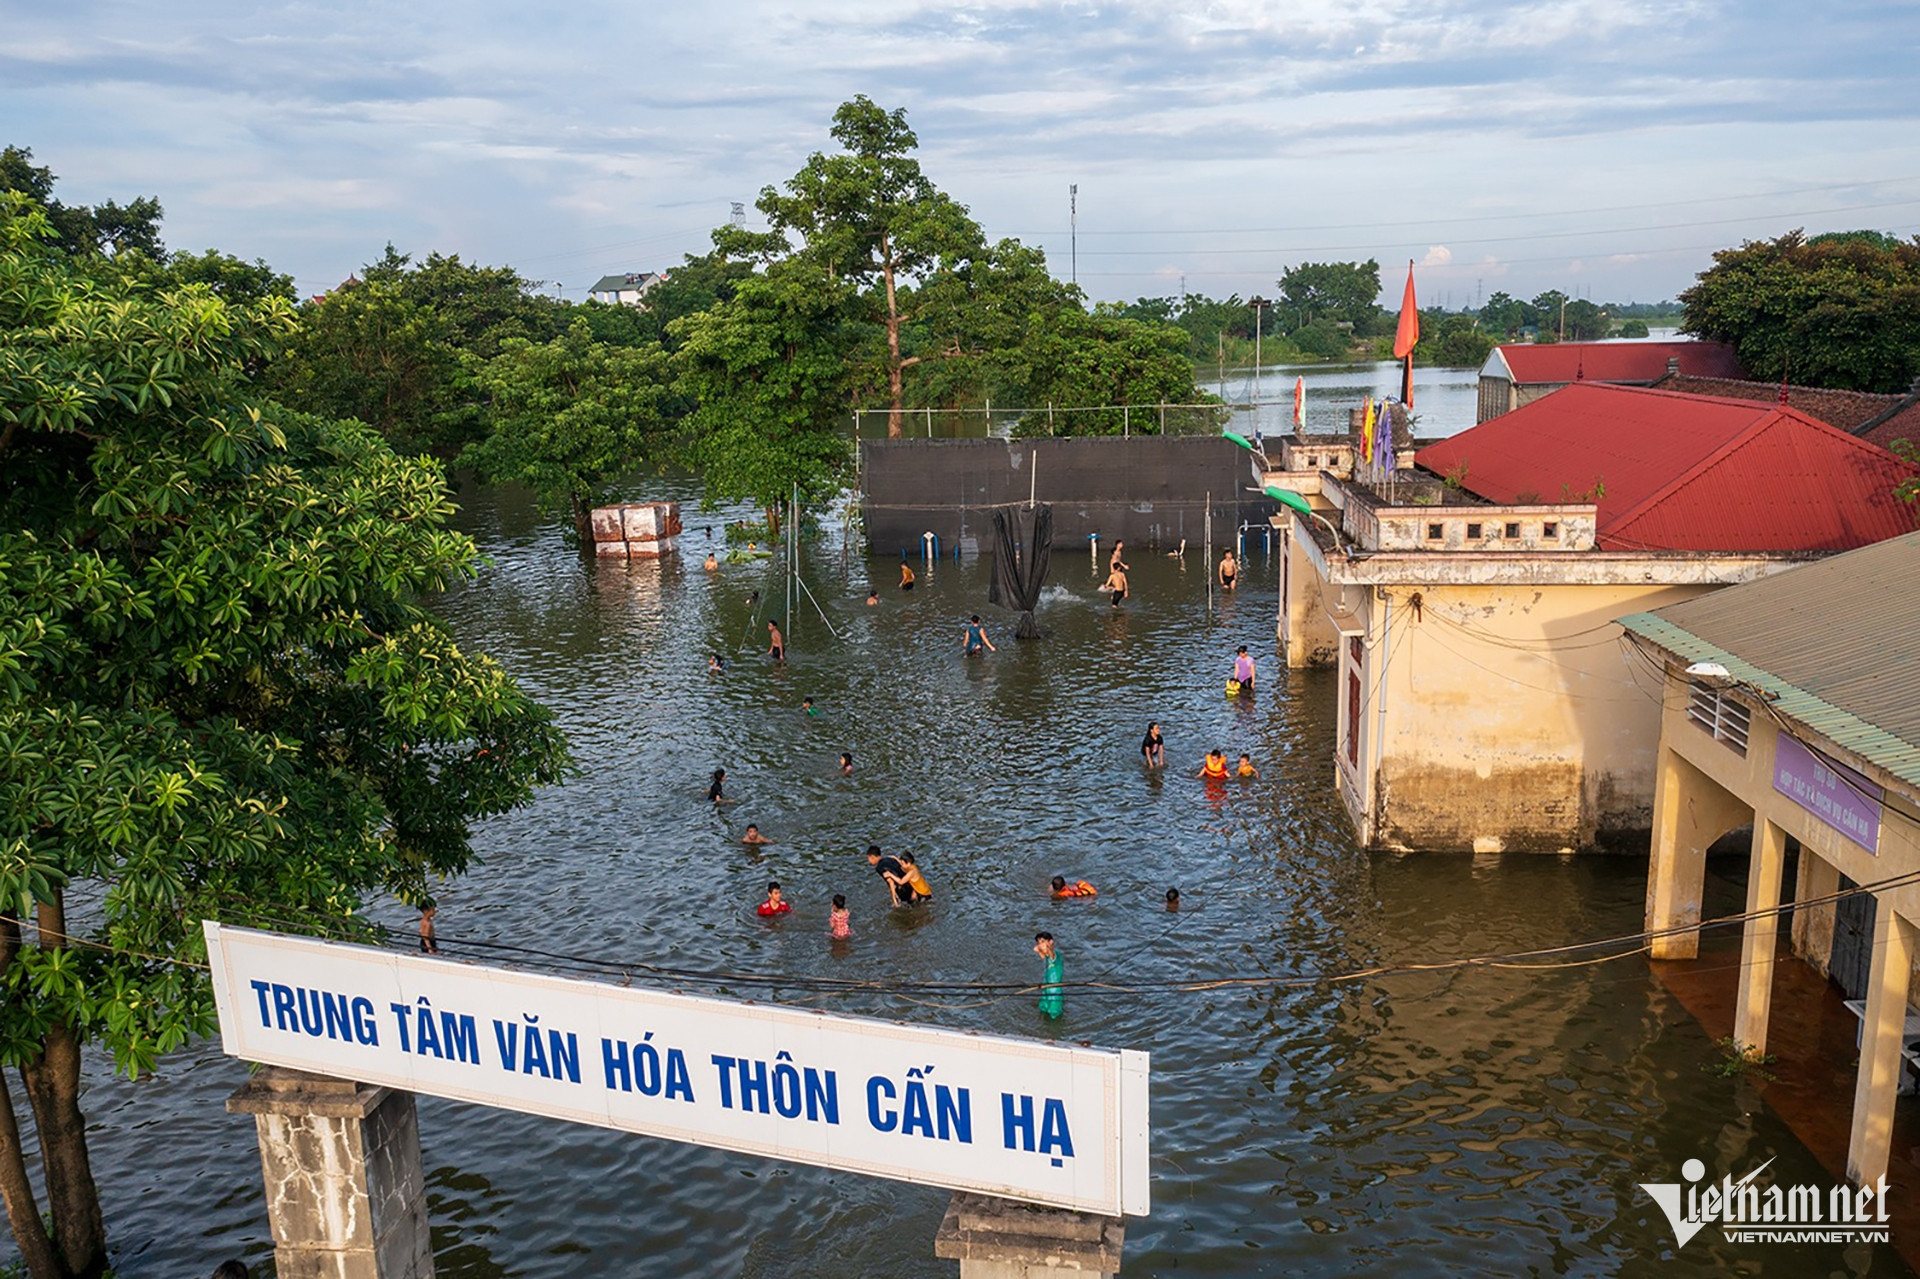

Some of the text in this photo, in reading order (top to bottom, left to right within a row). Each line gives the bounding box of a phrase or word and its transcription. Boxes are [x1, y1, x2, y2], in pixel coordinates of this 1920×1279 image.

[251, 979, 1075, 1168] TRUNG TÂM VĂN HÓA THÔN CẤN HẠ
